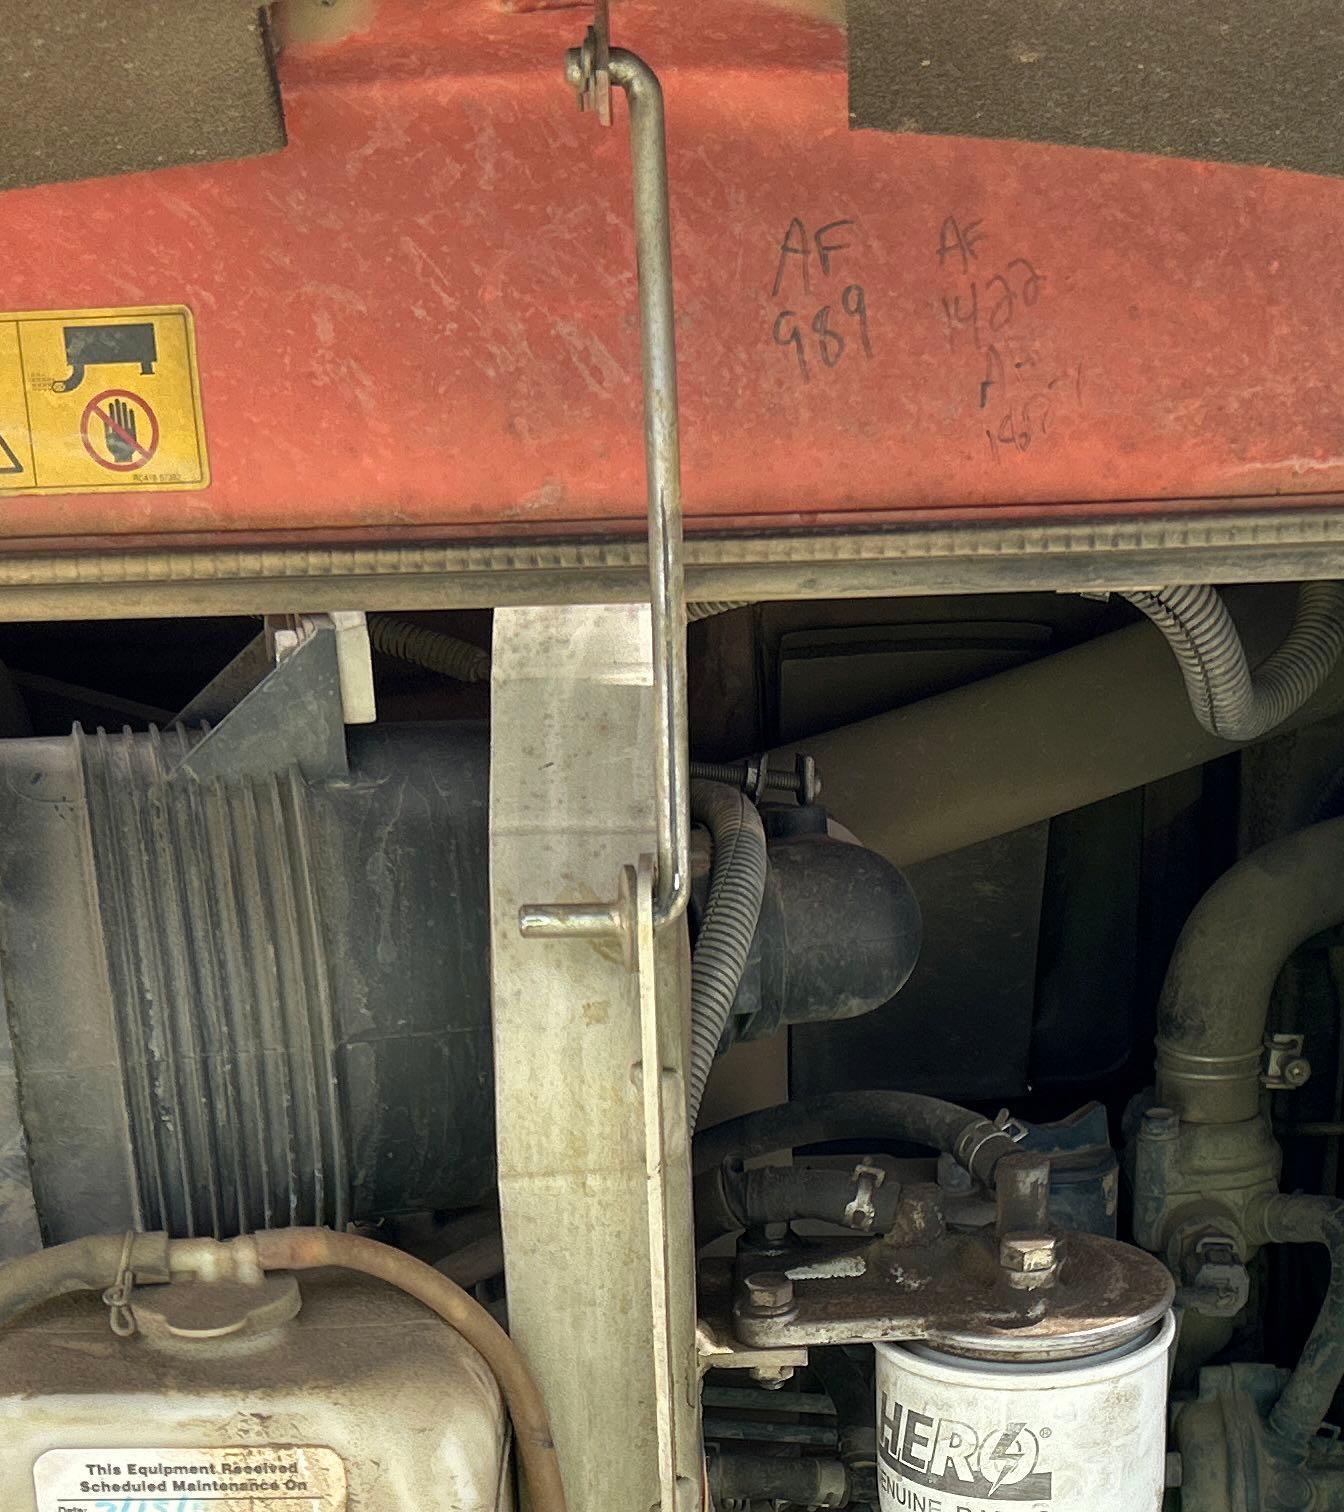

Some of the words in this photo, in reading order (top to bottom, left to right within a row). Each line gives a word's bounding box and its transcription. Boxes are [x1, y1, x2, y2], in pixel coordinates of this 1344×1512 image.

[771, 217, 854, 297] AF
[772, 283, 874, 385] 989
[85, 1463, 121, 1476] This
[127, 1463, 216, 1478] Equipment
[221, 1461, 299, 1475] Received
[878, 1390, 1040, 1487] HERO
[80, 1480, 167, 1493] Scheduled
[172, 1479, 280, 1493] Maintenance
[284, 1479, 307, 1492] On
